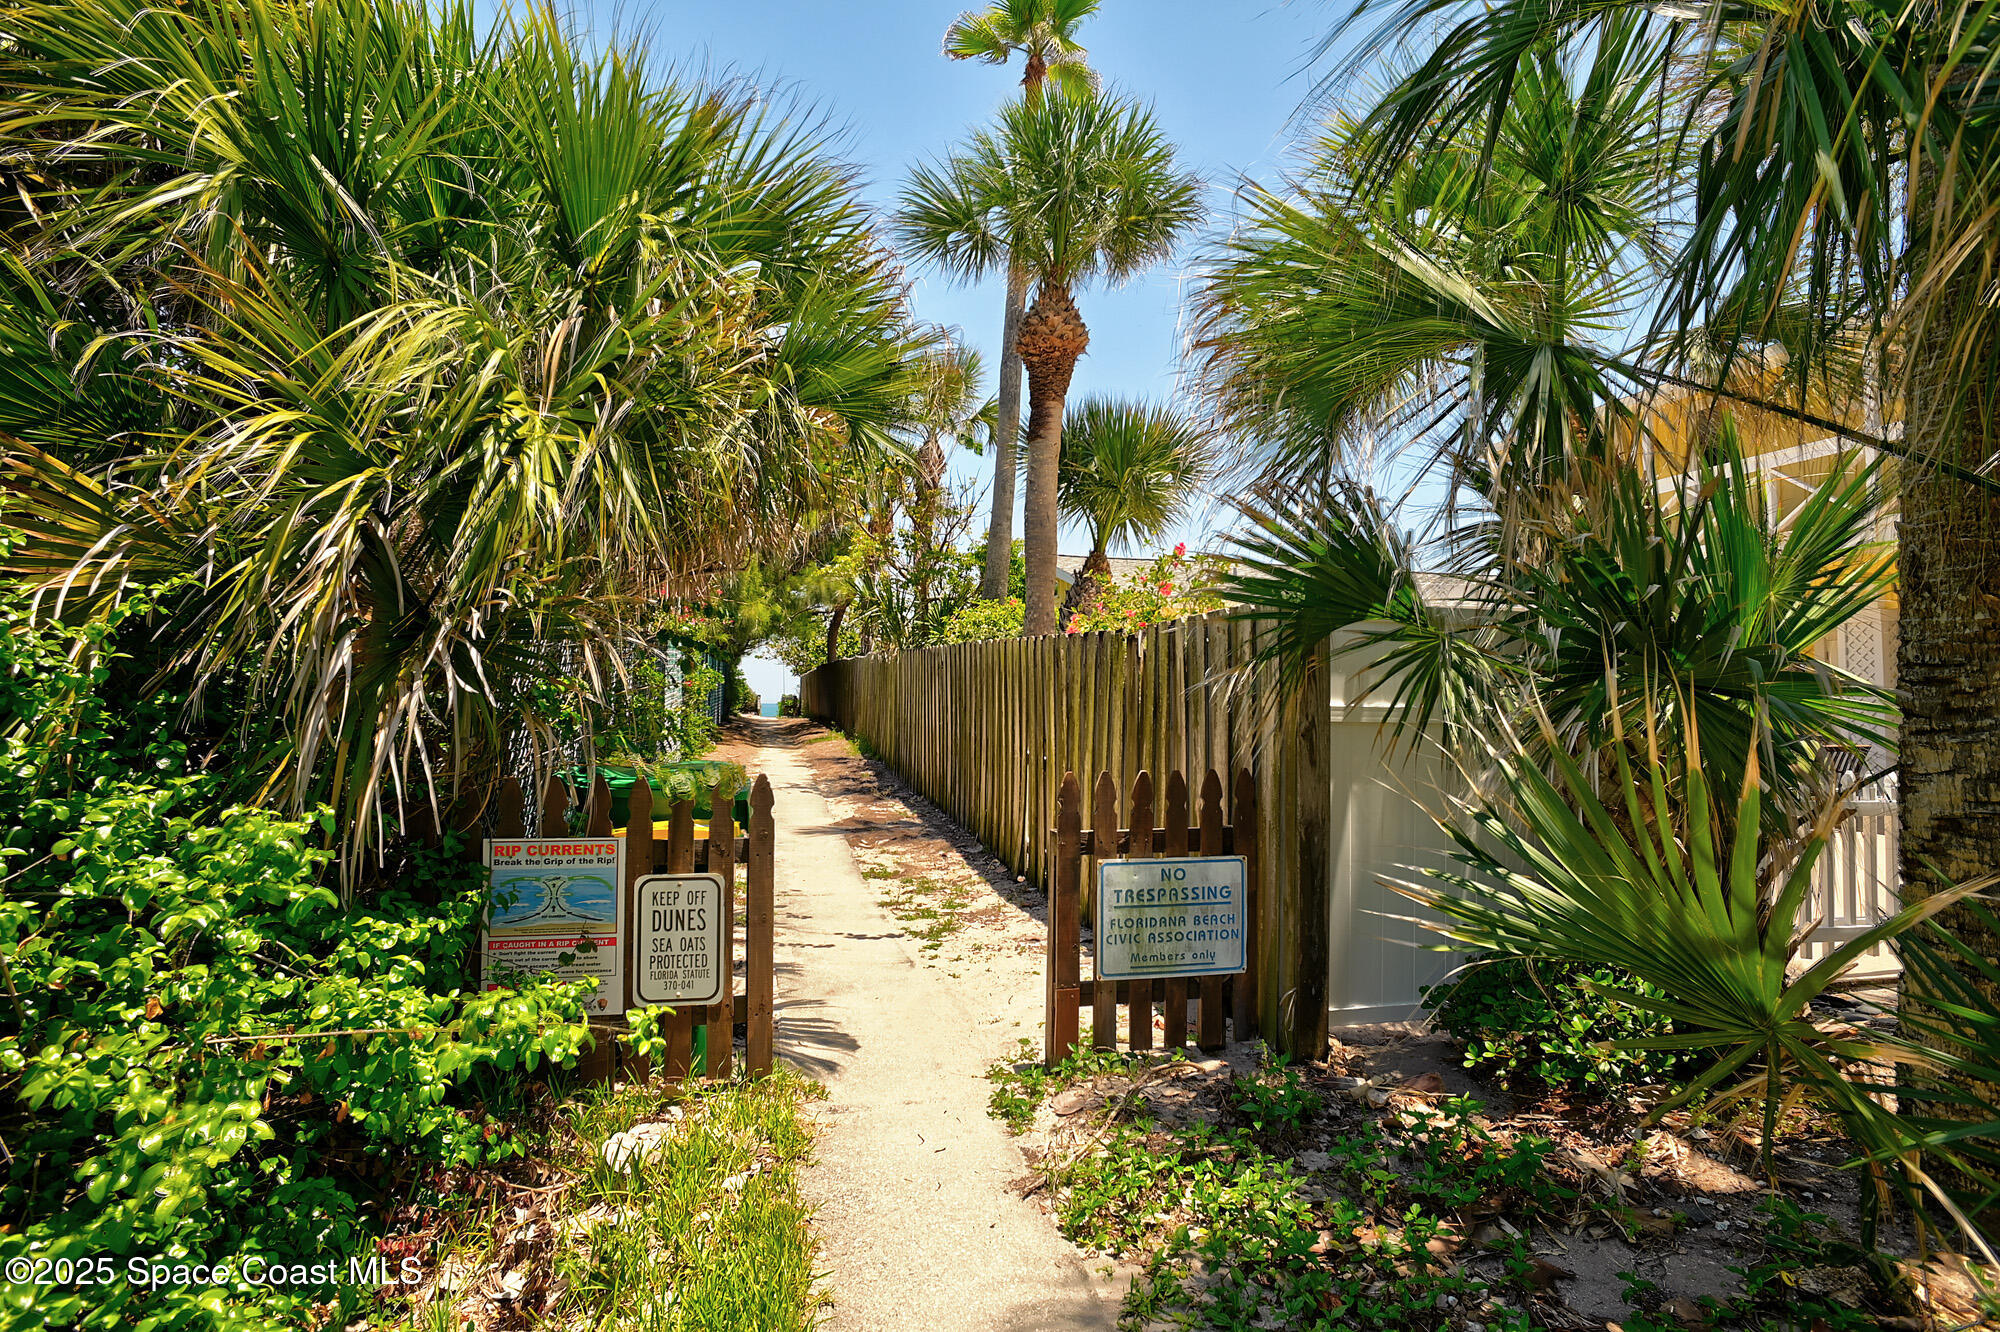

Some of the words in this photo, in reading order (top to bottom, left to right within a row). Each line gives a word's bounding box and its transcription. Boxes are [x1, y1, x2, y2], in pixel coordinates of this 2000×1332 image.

[494, 845, 521, 856] RIP
[527, 844, 616, 856] CURRENTS
[493, 858, 522, 866] Break
[544, 858, 563, 867] Grip
[596, 857, 616, 865] Rip!
[1160, 867, 1186, 882] NO
[652, 891, 680, 907] KEEP
[687, 890, 707, 905] OFF
[1113, 885, 1232, 904] TRESPASSING
[652, 908, 706, 932] DUNES
[1110, 915, 1186, 930] FLORIDANA
[1193, 913, 1236, 926] BEACH
[502, 941, 536, 949] CAUGHT
[651, 938, 673, 953] SEA
[680, 936, 706, 952] OATS
[1105, 933, 1141, 946] CIVIC
[1147, 928, 1239, 944] ASSOCIATION
[649, 953, 708, 970] PROTECTED
[1130, 951, 1186, 963] Members
[1192, 949, 1216, 962] only
[650, 970, 679, 980] FLORIDA
[682, 969, 710, 979] STATUTE
[663, 980, 694, 991] 370-041
